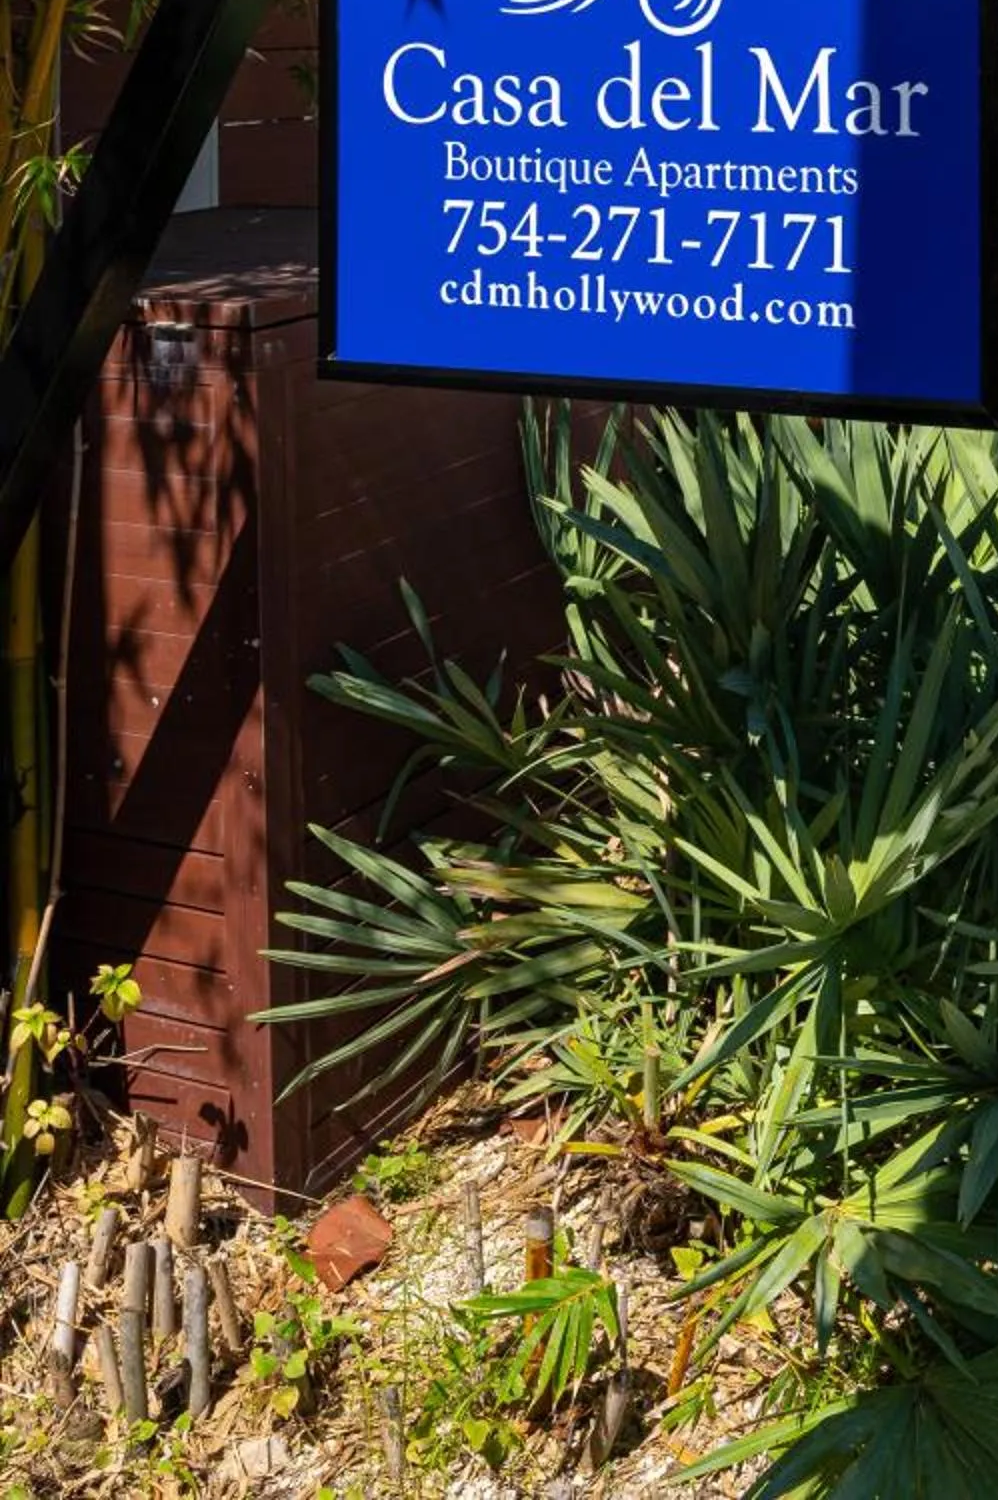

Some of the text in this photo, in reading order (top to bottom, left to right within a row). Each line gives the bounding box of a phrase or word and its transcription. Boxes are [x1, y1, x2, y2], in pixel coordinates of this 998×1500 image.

[382, 39, 929, 137] Casa del Mar
[443, 140, 859, 198] Boutique Apartments
[442, 198, 853, 274] 754-271-7171
[439, 267, 856, 328] cdmhollywood.com
